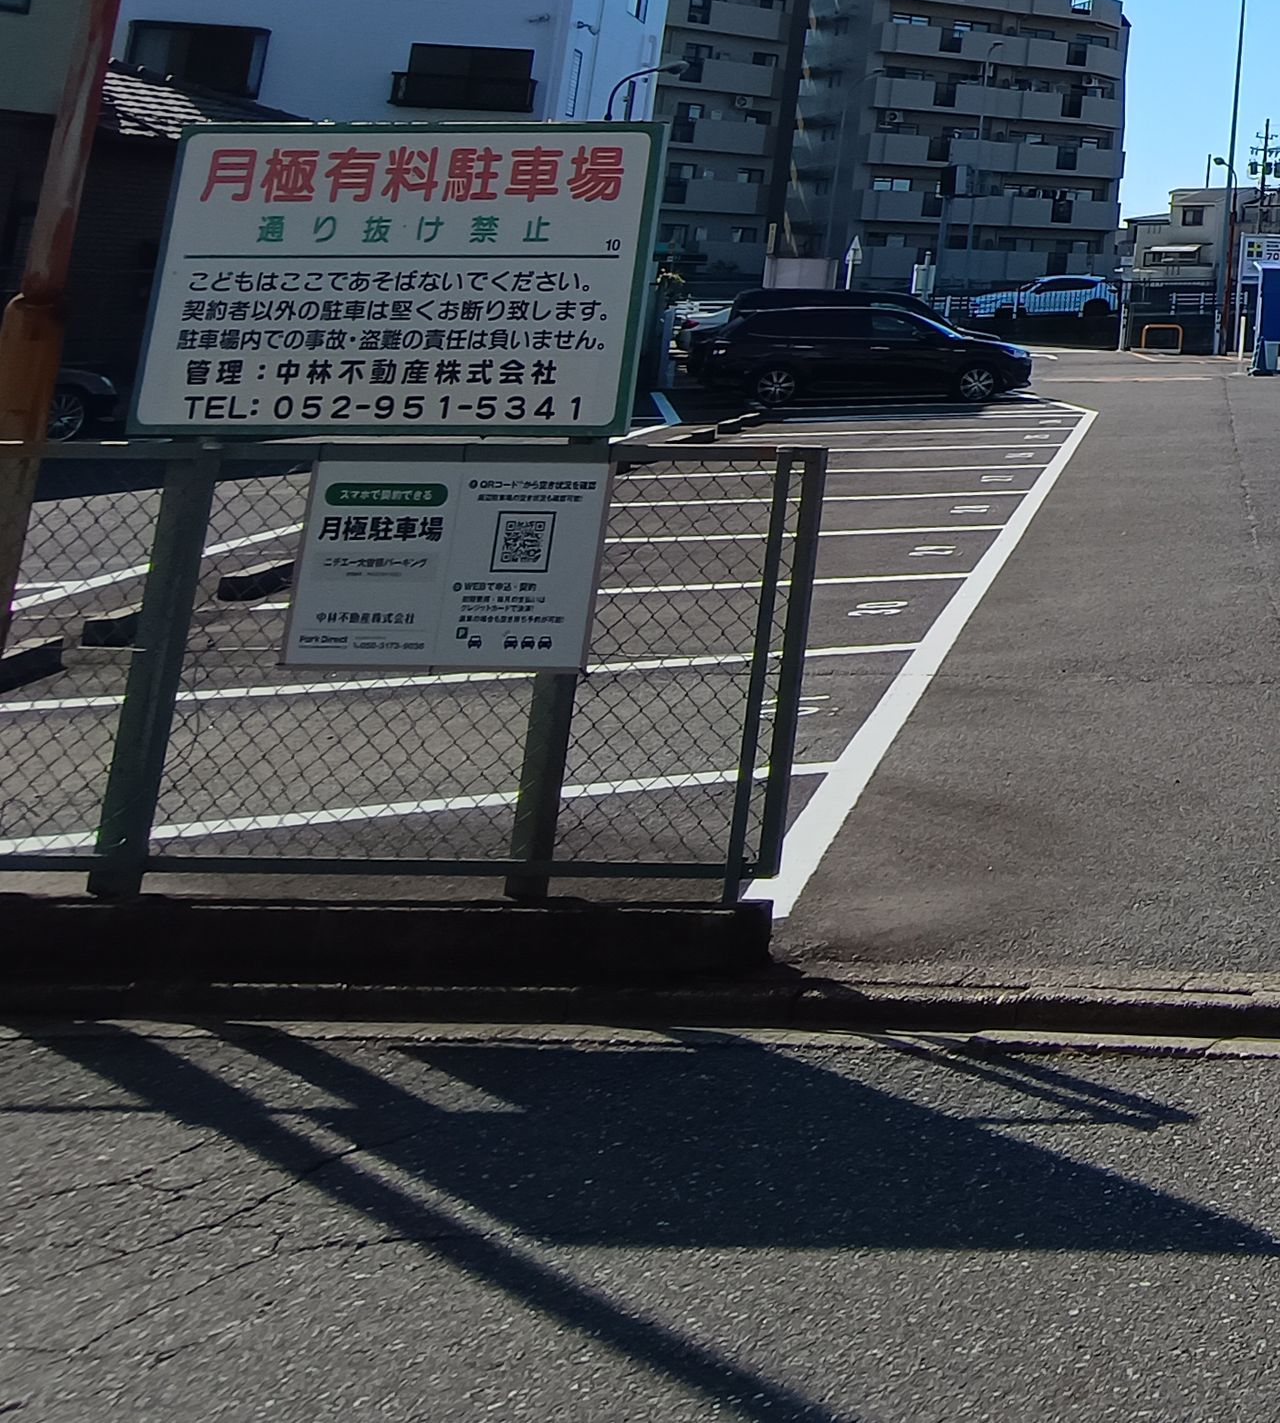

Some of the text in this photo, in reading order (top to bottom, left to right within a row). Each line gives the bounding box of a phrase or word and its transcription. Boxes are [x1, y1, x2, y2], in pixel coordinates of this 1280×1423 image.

[200, 146, 625, 203] 月極有料駐車場
[256, 216, 551, 244] 通り抜け禁止
[604, 239, 621, 252] 10
[189, 271, 591, 293] こどもはここであそばないでください。
[182, 299, 609, 323] 契約者以外の駐車は堅くお断り致します。
[177, 329, 607, 352] 駐車場内での事故・盗難の責任は負いません。
[185, 359, 557, 386] 管理：中林不動産株式会社
[318, 516, 444, 542] 月極駐車場
[316, 612, 415, 624] 中林不動産株式会社
